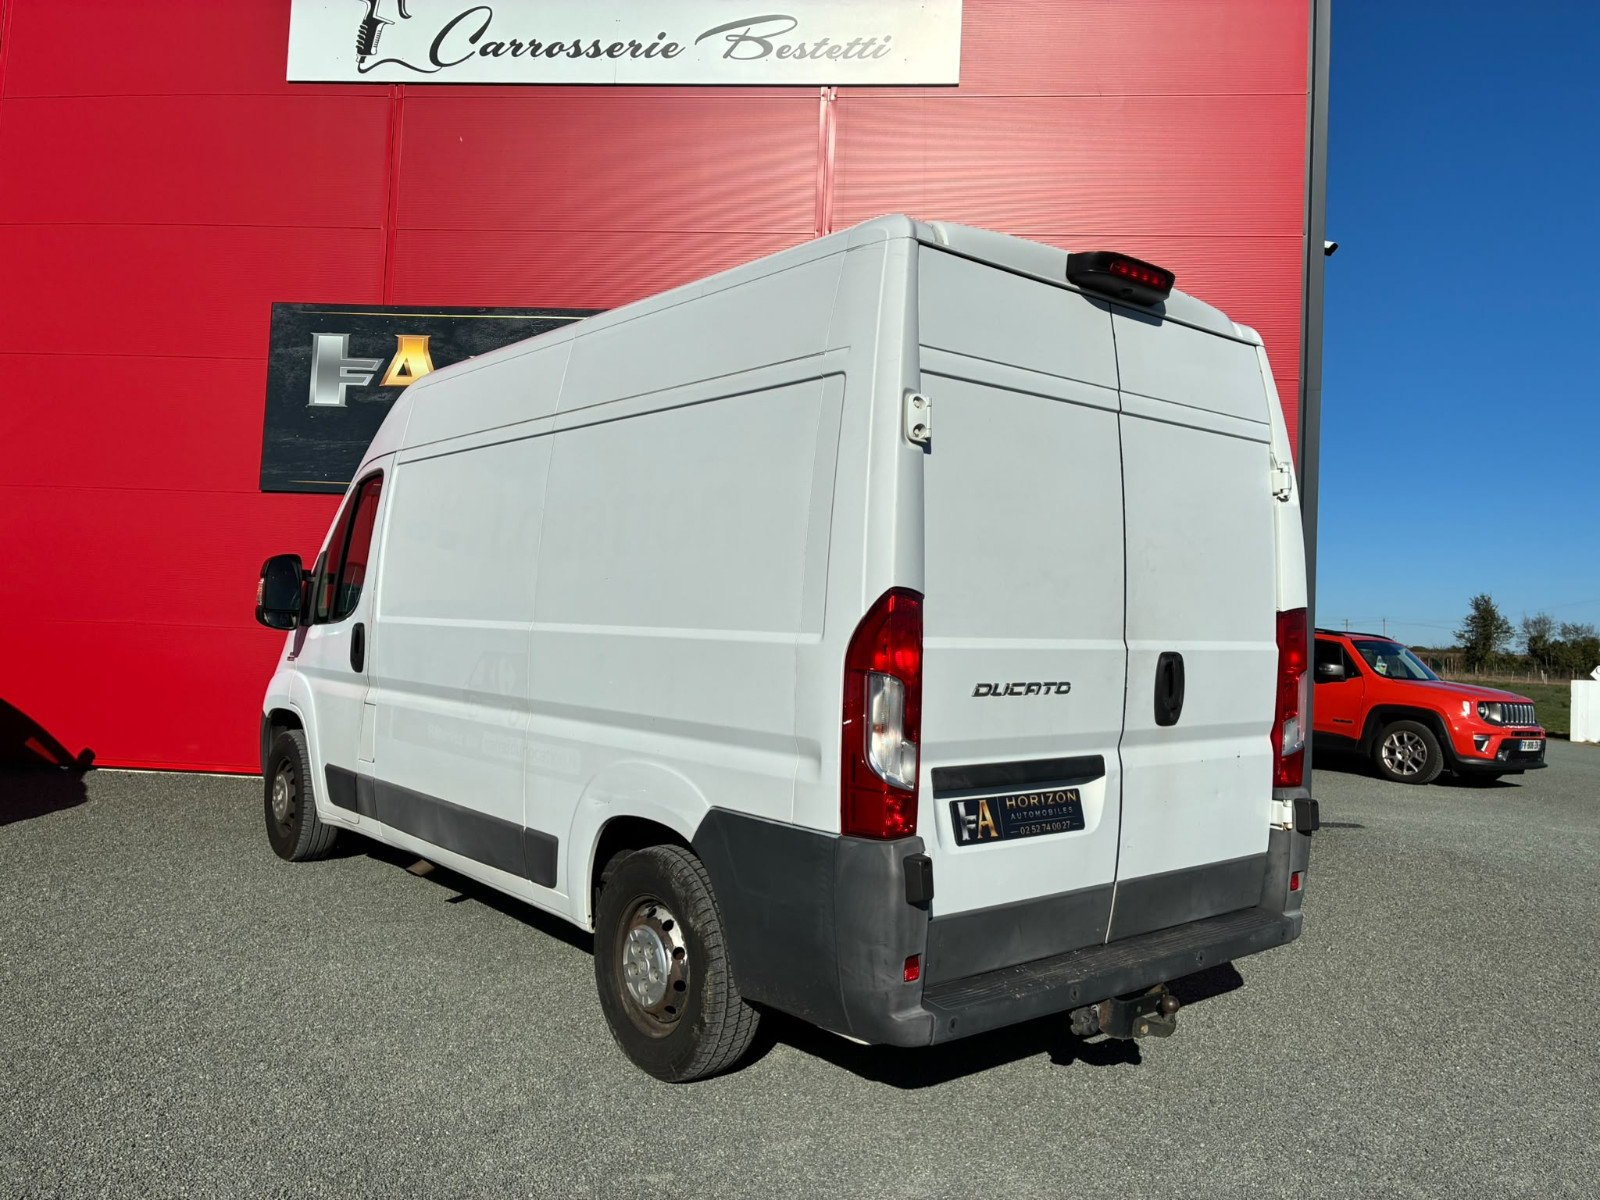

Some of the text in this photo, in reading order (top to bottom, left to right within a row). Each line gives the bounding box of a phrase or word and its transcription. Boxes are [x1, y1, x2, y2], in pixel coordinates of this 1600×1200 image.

[429, 5, 892, 68] Carrosserie Bestetti
[971, 681, 1072, 698] DUCATO
[1006, 791, 1077, 810] HORIZON
[1010, 806, 1073, 820] AUTOMOBILES
